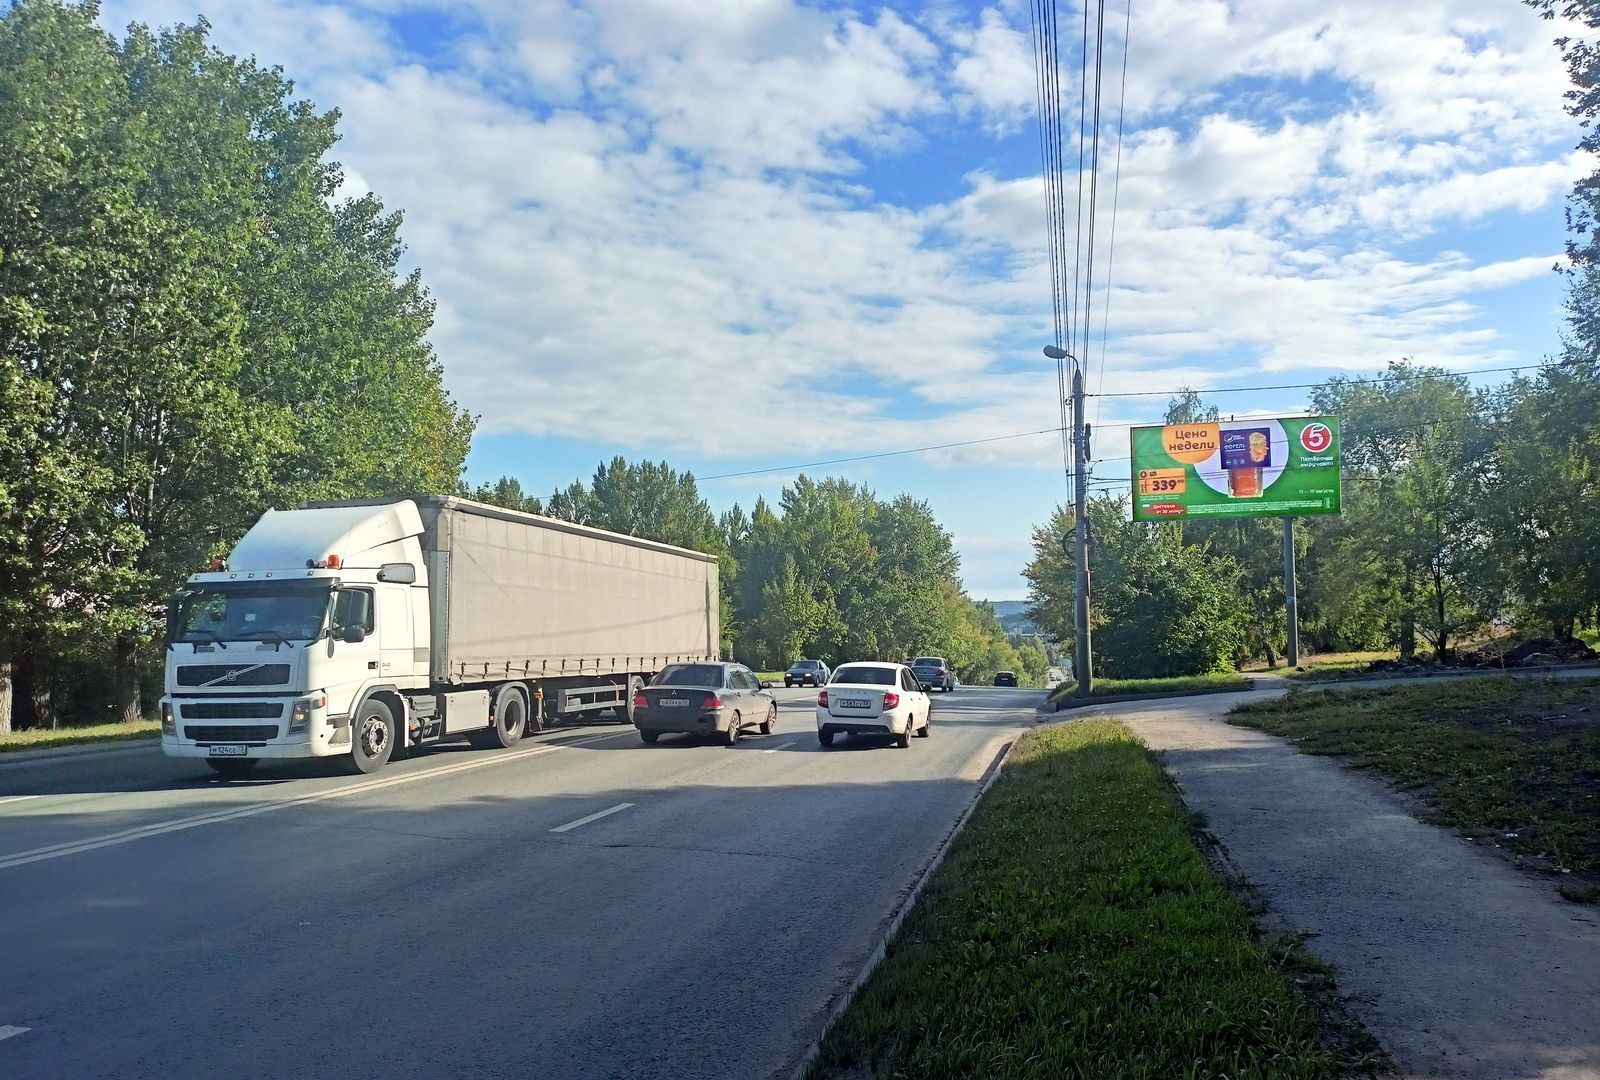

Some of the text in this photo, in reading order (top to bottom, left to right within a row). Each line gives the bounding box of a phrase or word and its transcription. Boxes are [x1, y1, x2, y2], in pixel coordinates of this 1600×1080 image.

[1175, 430, 1207, 440] Цена
[1309, 425, 1324, 447] 5
[1169, 441, 1215, 451] недели
[1152, 479, 1177, 491] 339
